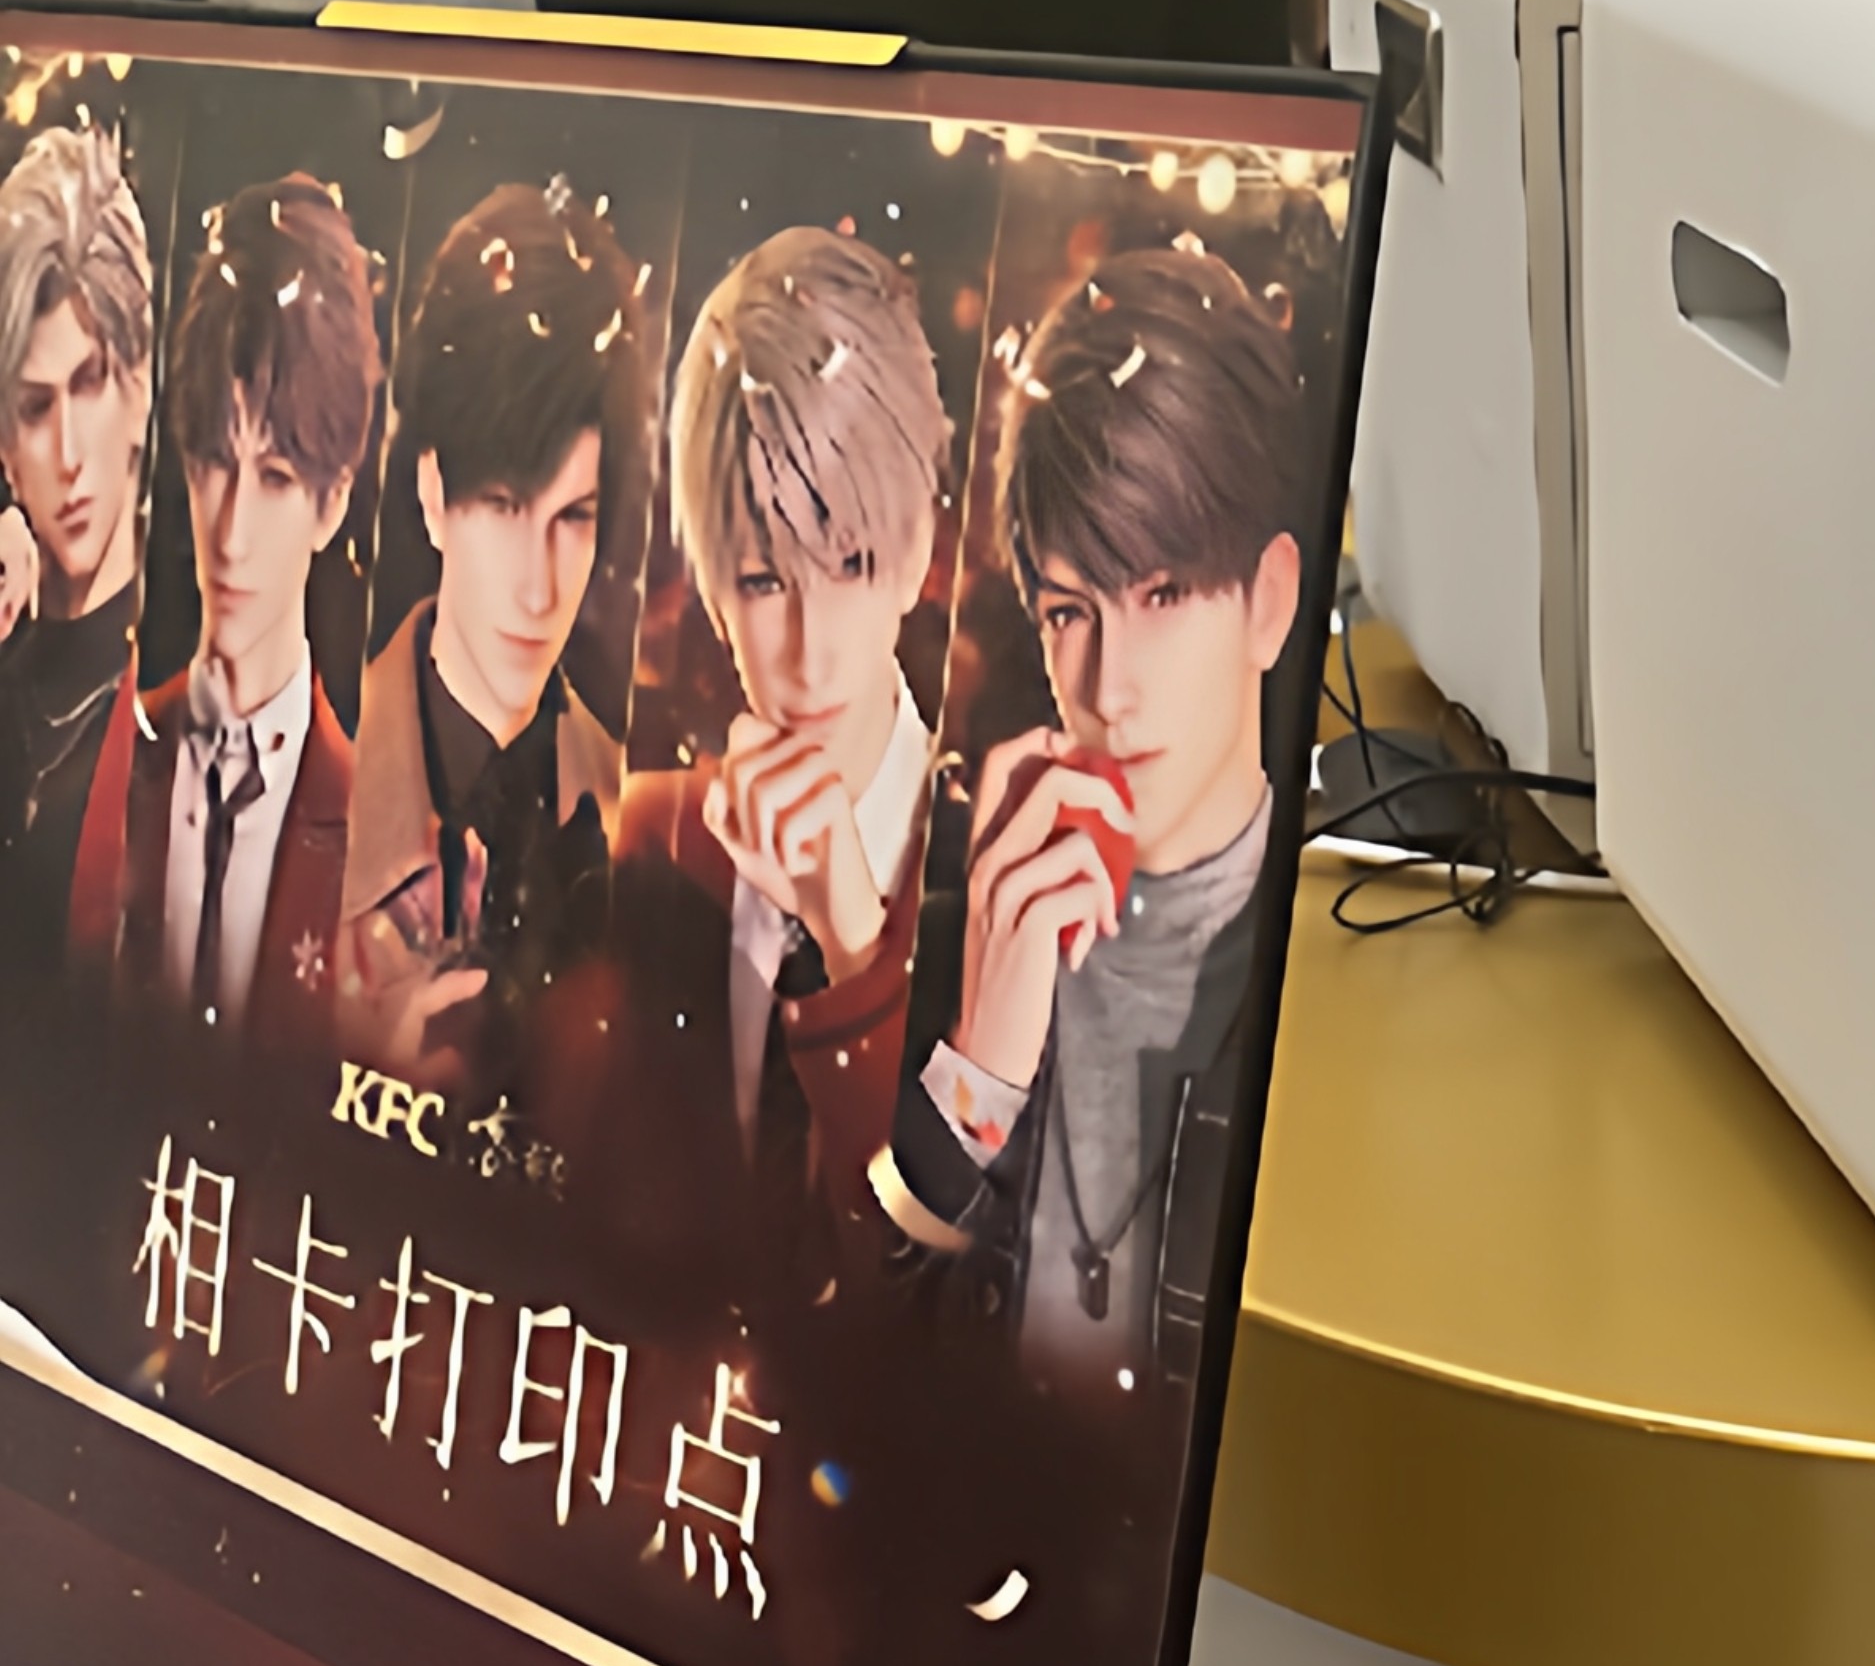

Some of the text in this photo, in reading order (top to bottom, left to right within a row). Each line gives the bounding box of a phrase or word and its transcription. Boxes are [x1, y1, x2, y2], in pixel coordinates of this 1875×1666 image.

[330, 1060, 446, 1158] KFC
[133, 1131, 783, 1623] 相卡打印点
